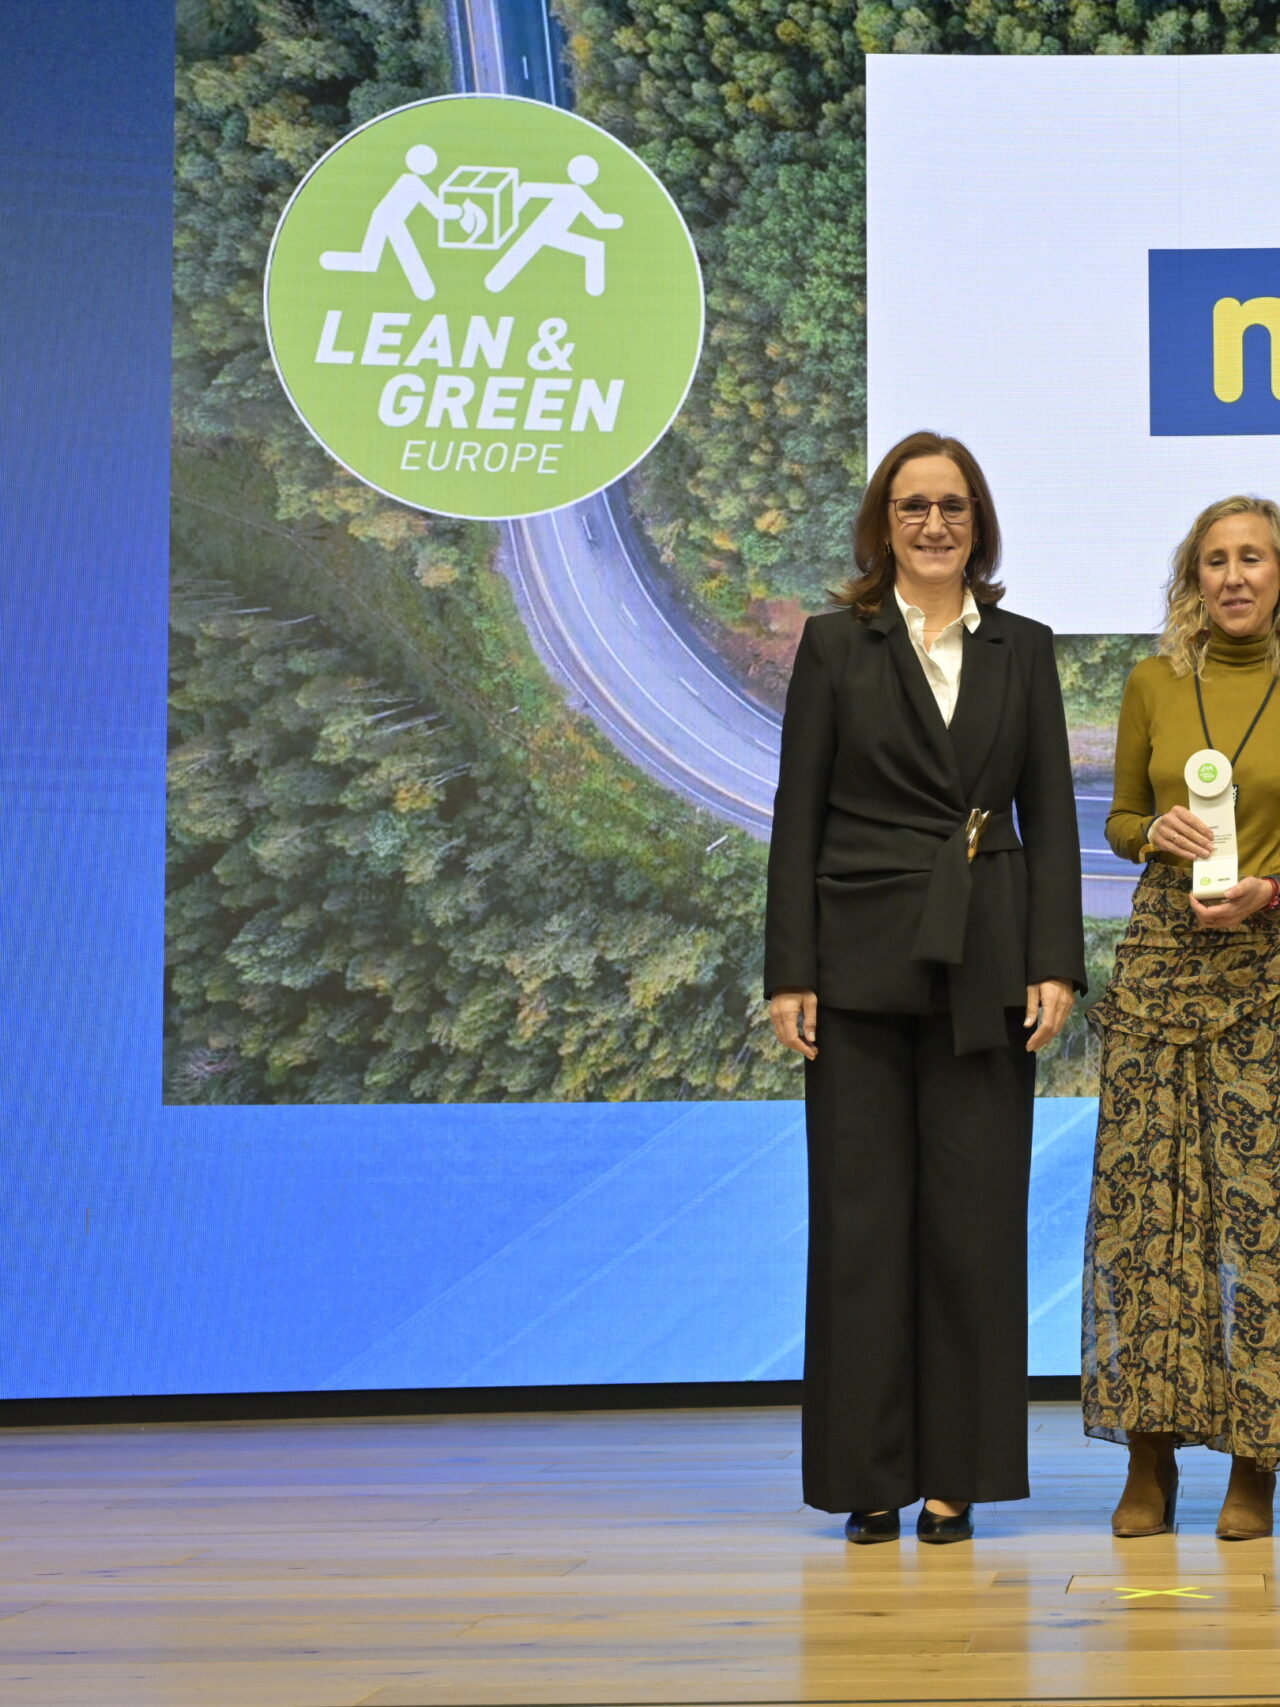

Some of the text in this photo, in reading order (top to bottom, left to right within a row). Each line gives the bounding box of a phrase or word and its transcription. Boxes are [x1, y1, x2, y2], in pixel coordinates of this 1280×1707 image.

[314, 309, 576, 372] LEAN &
[377, 372, 626, 433] GREEN
[400, 439, 564, 475] EUROPE
